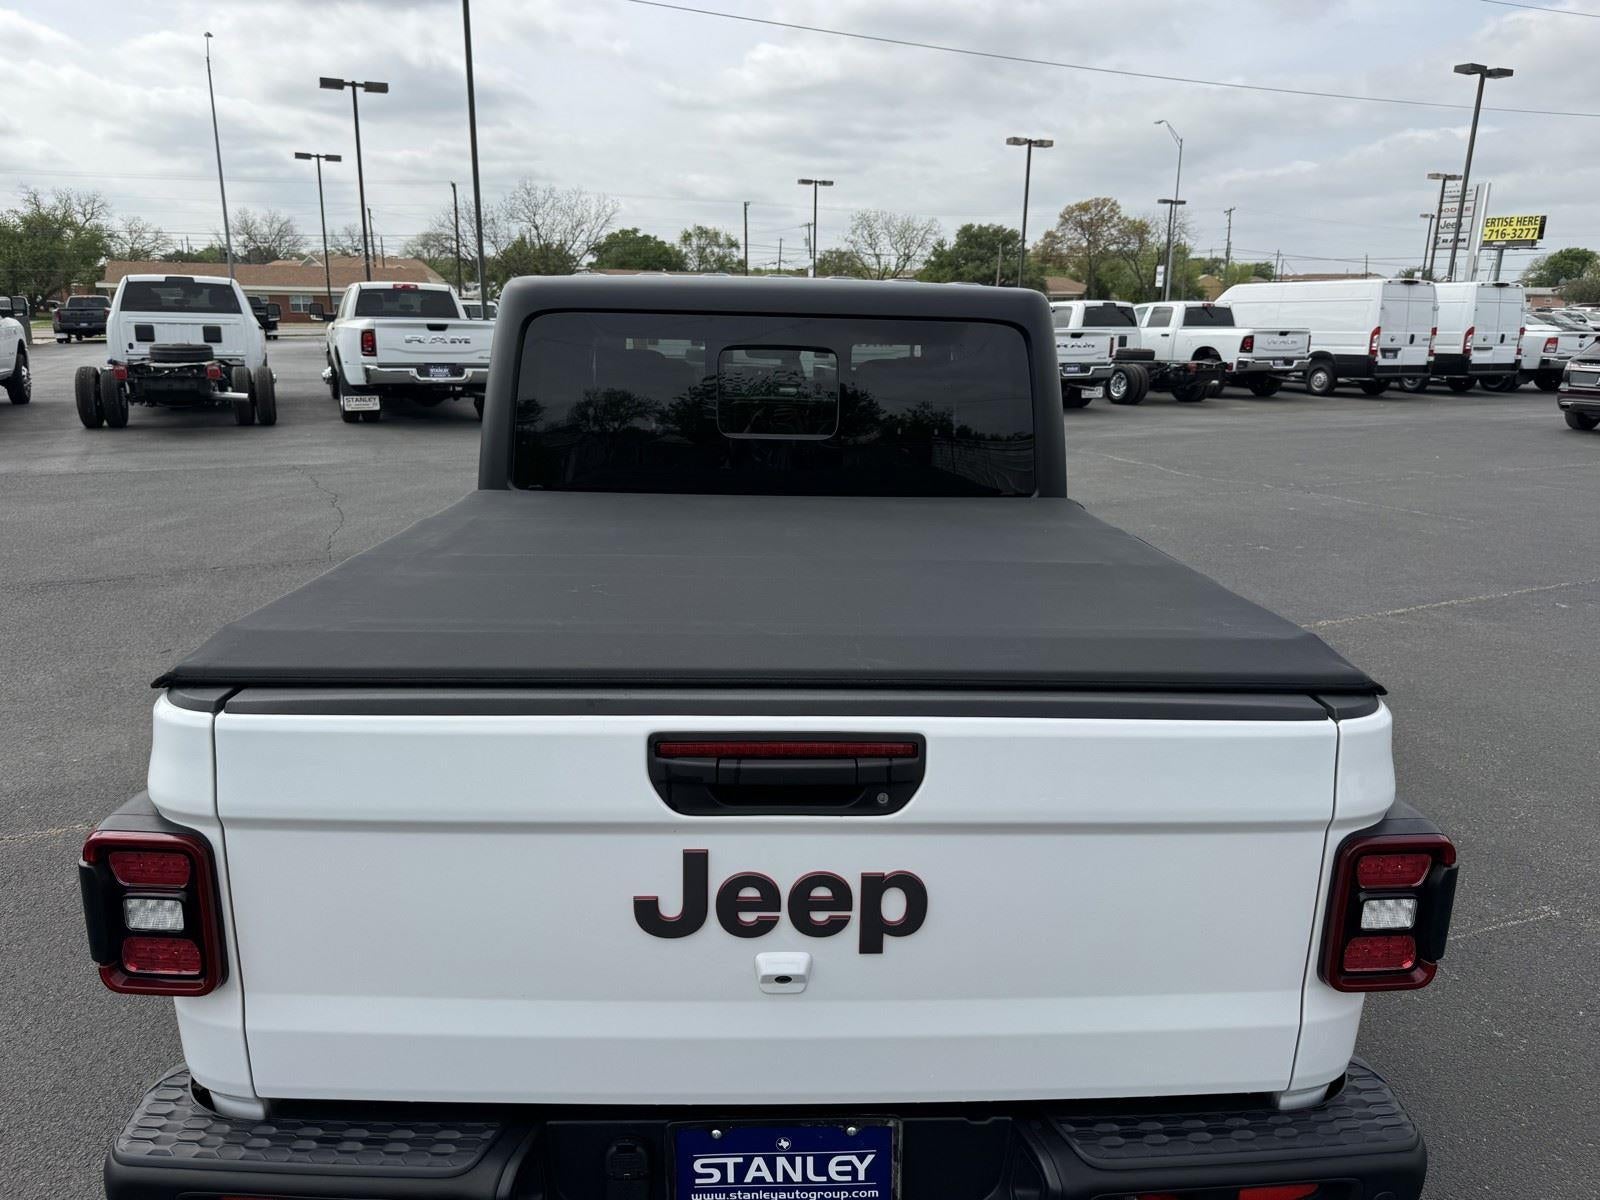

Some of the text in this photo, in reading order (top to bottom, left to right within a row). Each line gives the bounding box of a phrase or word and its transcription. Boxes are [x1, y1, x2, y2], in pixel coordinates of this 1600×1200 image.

[1485, 215, 1540, 228] ERTISE HERE
[1484, 227, 1538, 239] -716-3277
[633, 849, 928, 954] Jeep
[692, 1154, 876, 1184] STANLEY
[691, 1189, 879, 1200] www.stanleyautogroup.com
